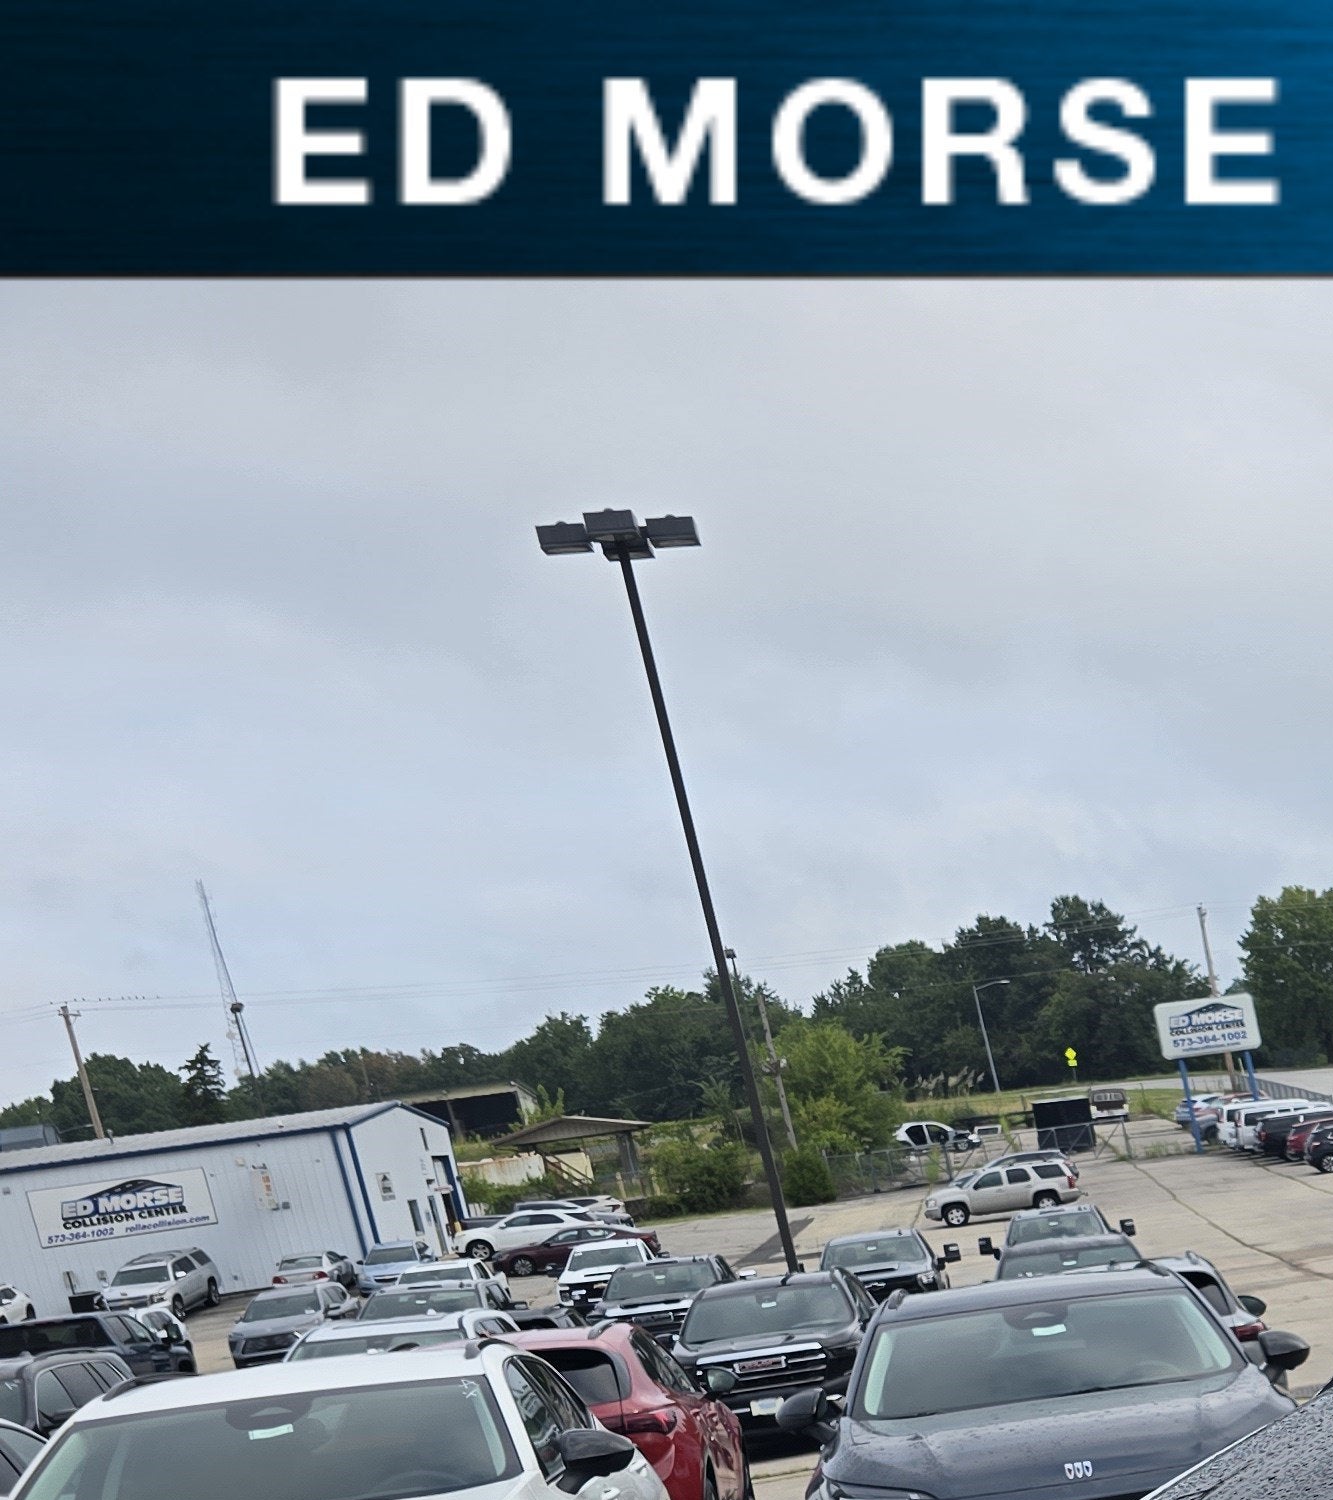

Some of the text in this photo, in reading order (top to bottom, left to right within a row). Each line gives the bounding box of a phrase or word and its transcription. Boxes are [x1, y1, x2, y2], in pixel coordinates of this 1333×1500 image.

[61, 1186, 184, 1220] ED MORSE
[63, 1205, 188, 1230] COLLISION CENTER
[47, 1227, 115, 1244] 573-364-1002
